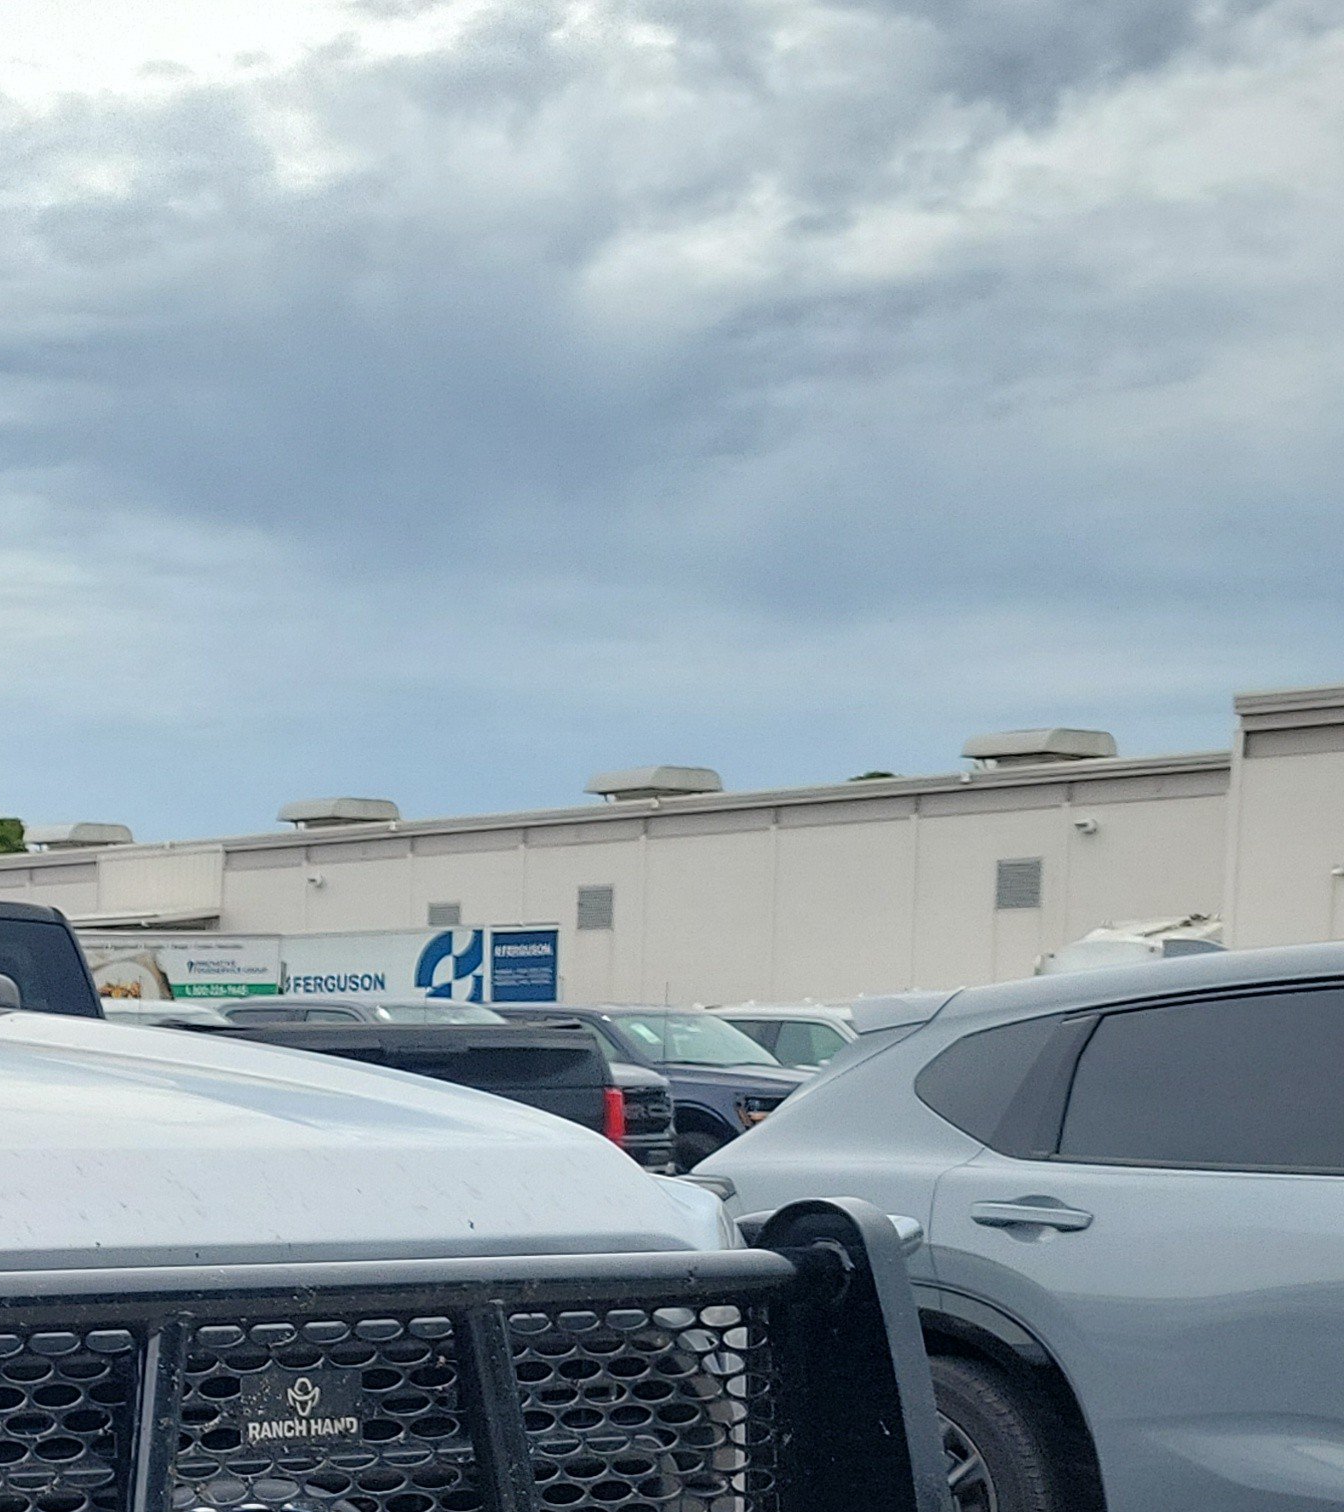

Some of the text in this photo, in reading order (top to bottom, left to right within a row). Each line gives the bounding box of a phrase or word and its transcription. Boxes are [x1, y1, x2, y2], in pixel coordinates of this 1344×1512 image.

[293, 972, 386, 993] FERGUSON
[247, 1417, 359, 1441] RANCH HAND
